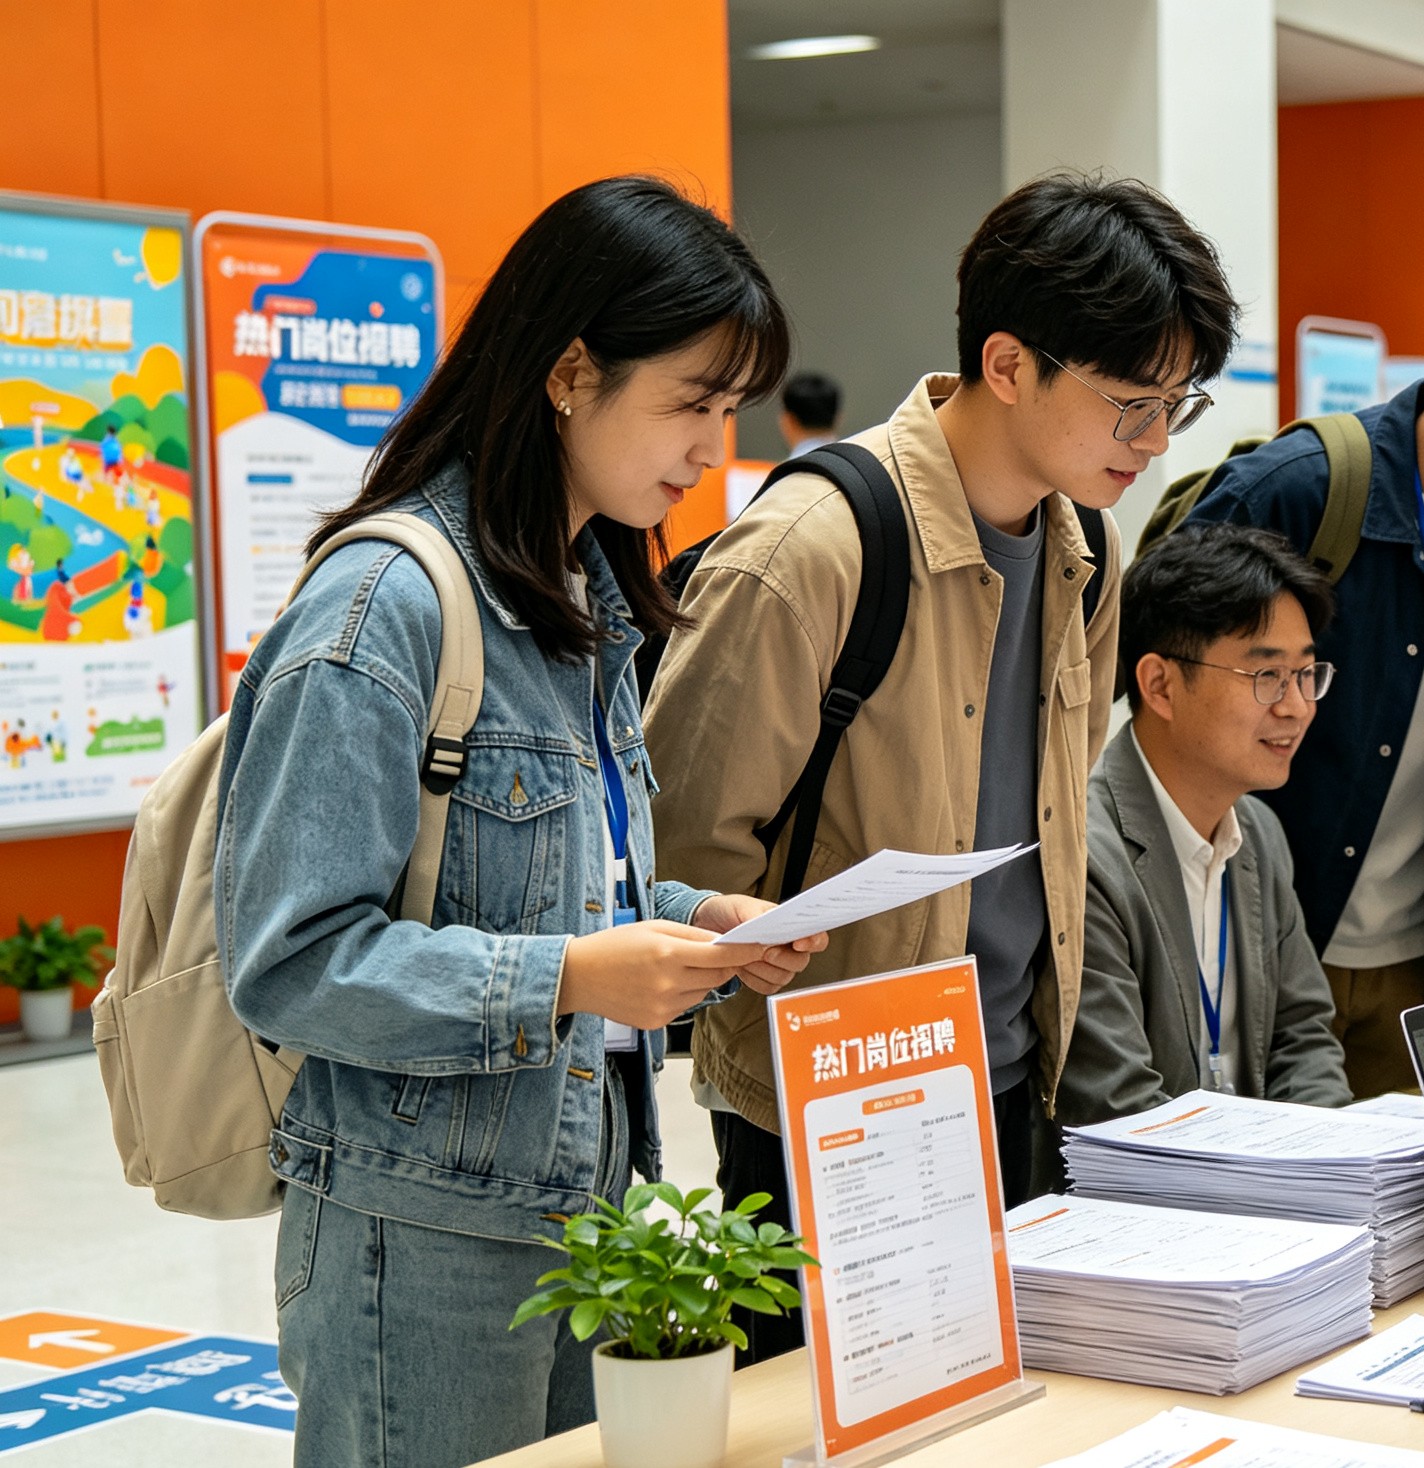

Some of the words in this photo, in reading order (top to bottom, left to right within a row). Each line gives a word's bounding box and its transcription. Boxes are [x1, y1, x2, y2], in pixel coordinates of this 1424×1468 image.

[234, 310, 421, 368] 热门岗位招聘
[811, 1017, 956, 1083] 热门岗位招聘
